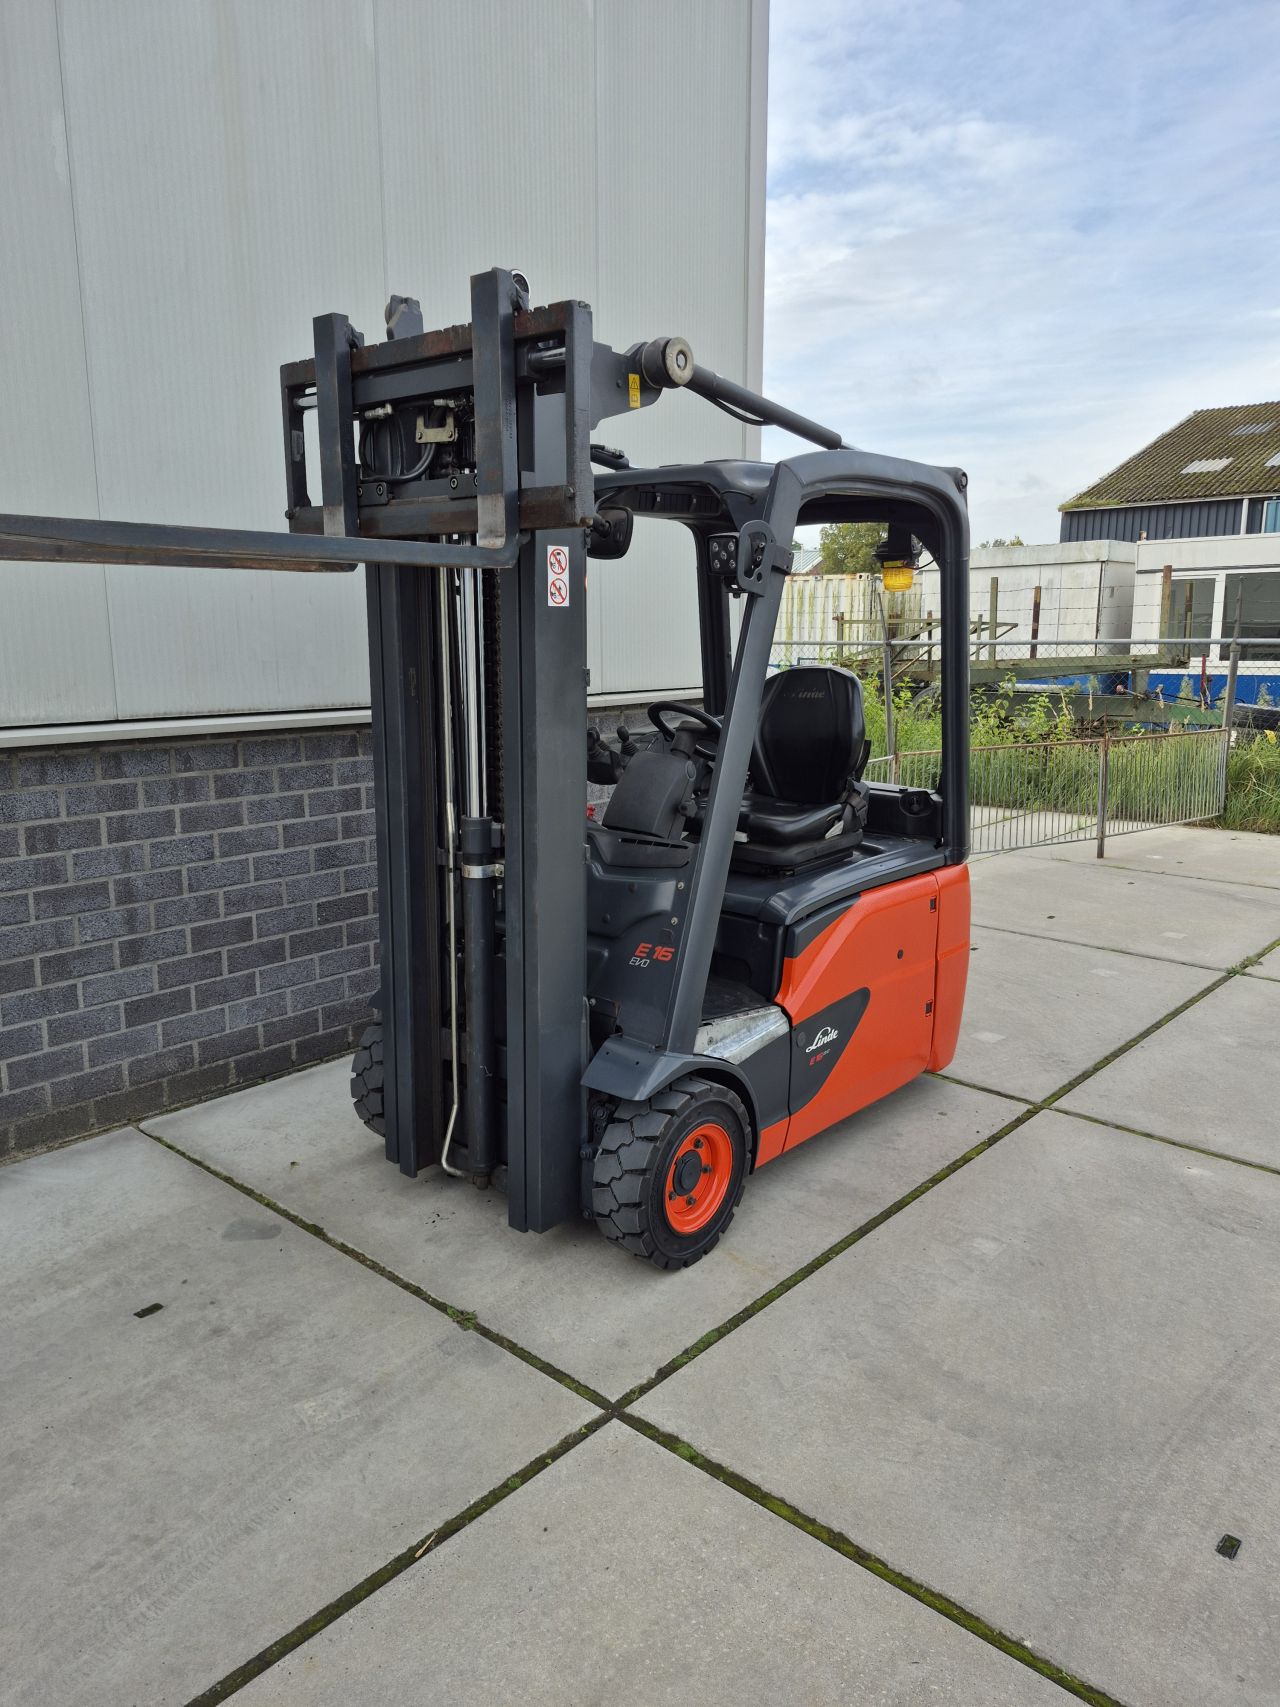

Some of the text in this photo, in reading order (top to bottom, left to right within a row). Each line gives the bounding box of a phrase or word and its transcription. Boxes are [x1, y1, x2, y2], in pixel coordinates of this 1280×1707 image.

[635, 943, 675, 961] E 16
[629, 957, 650, 968] EVO
[805, 1026, 839, 1053] Linde
